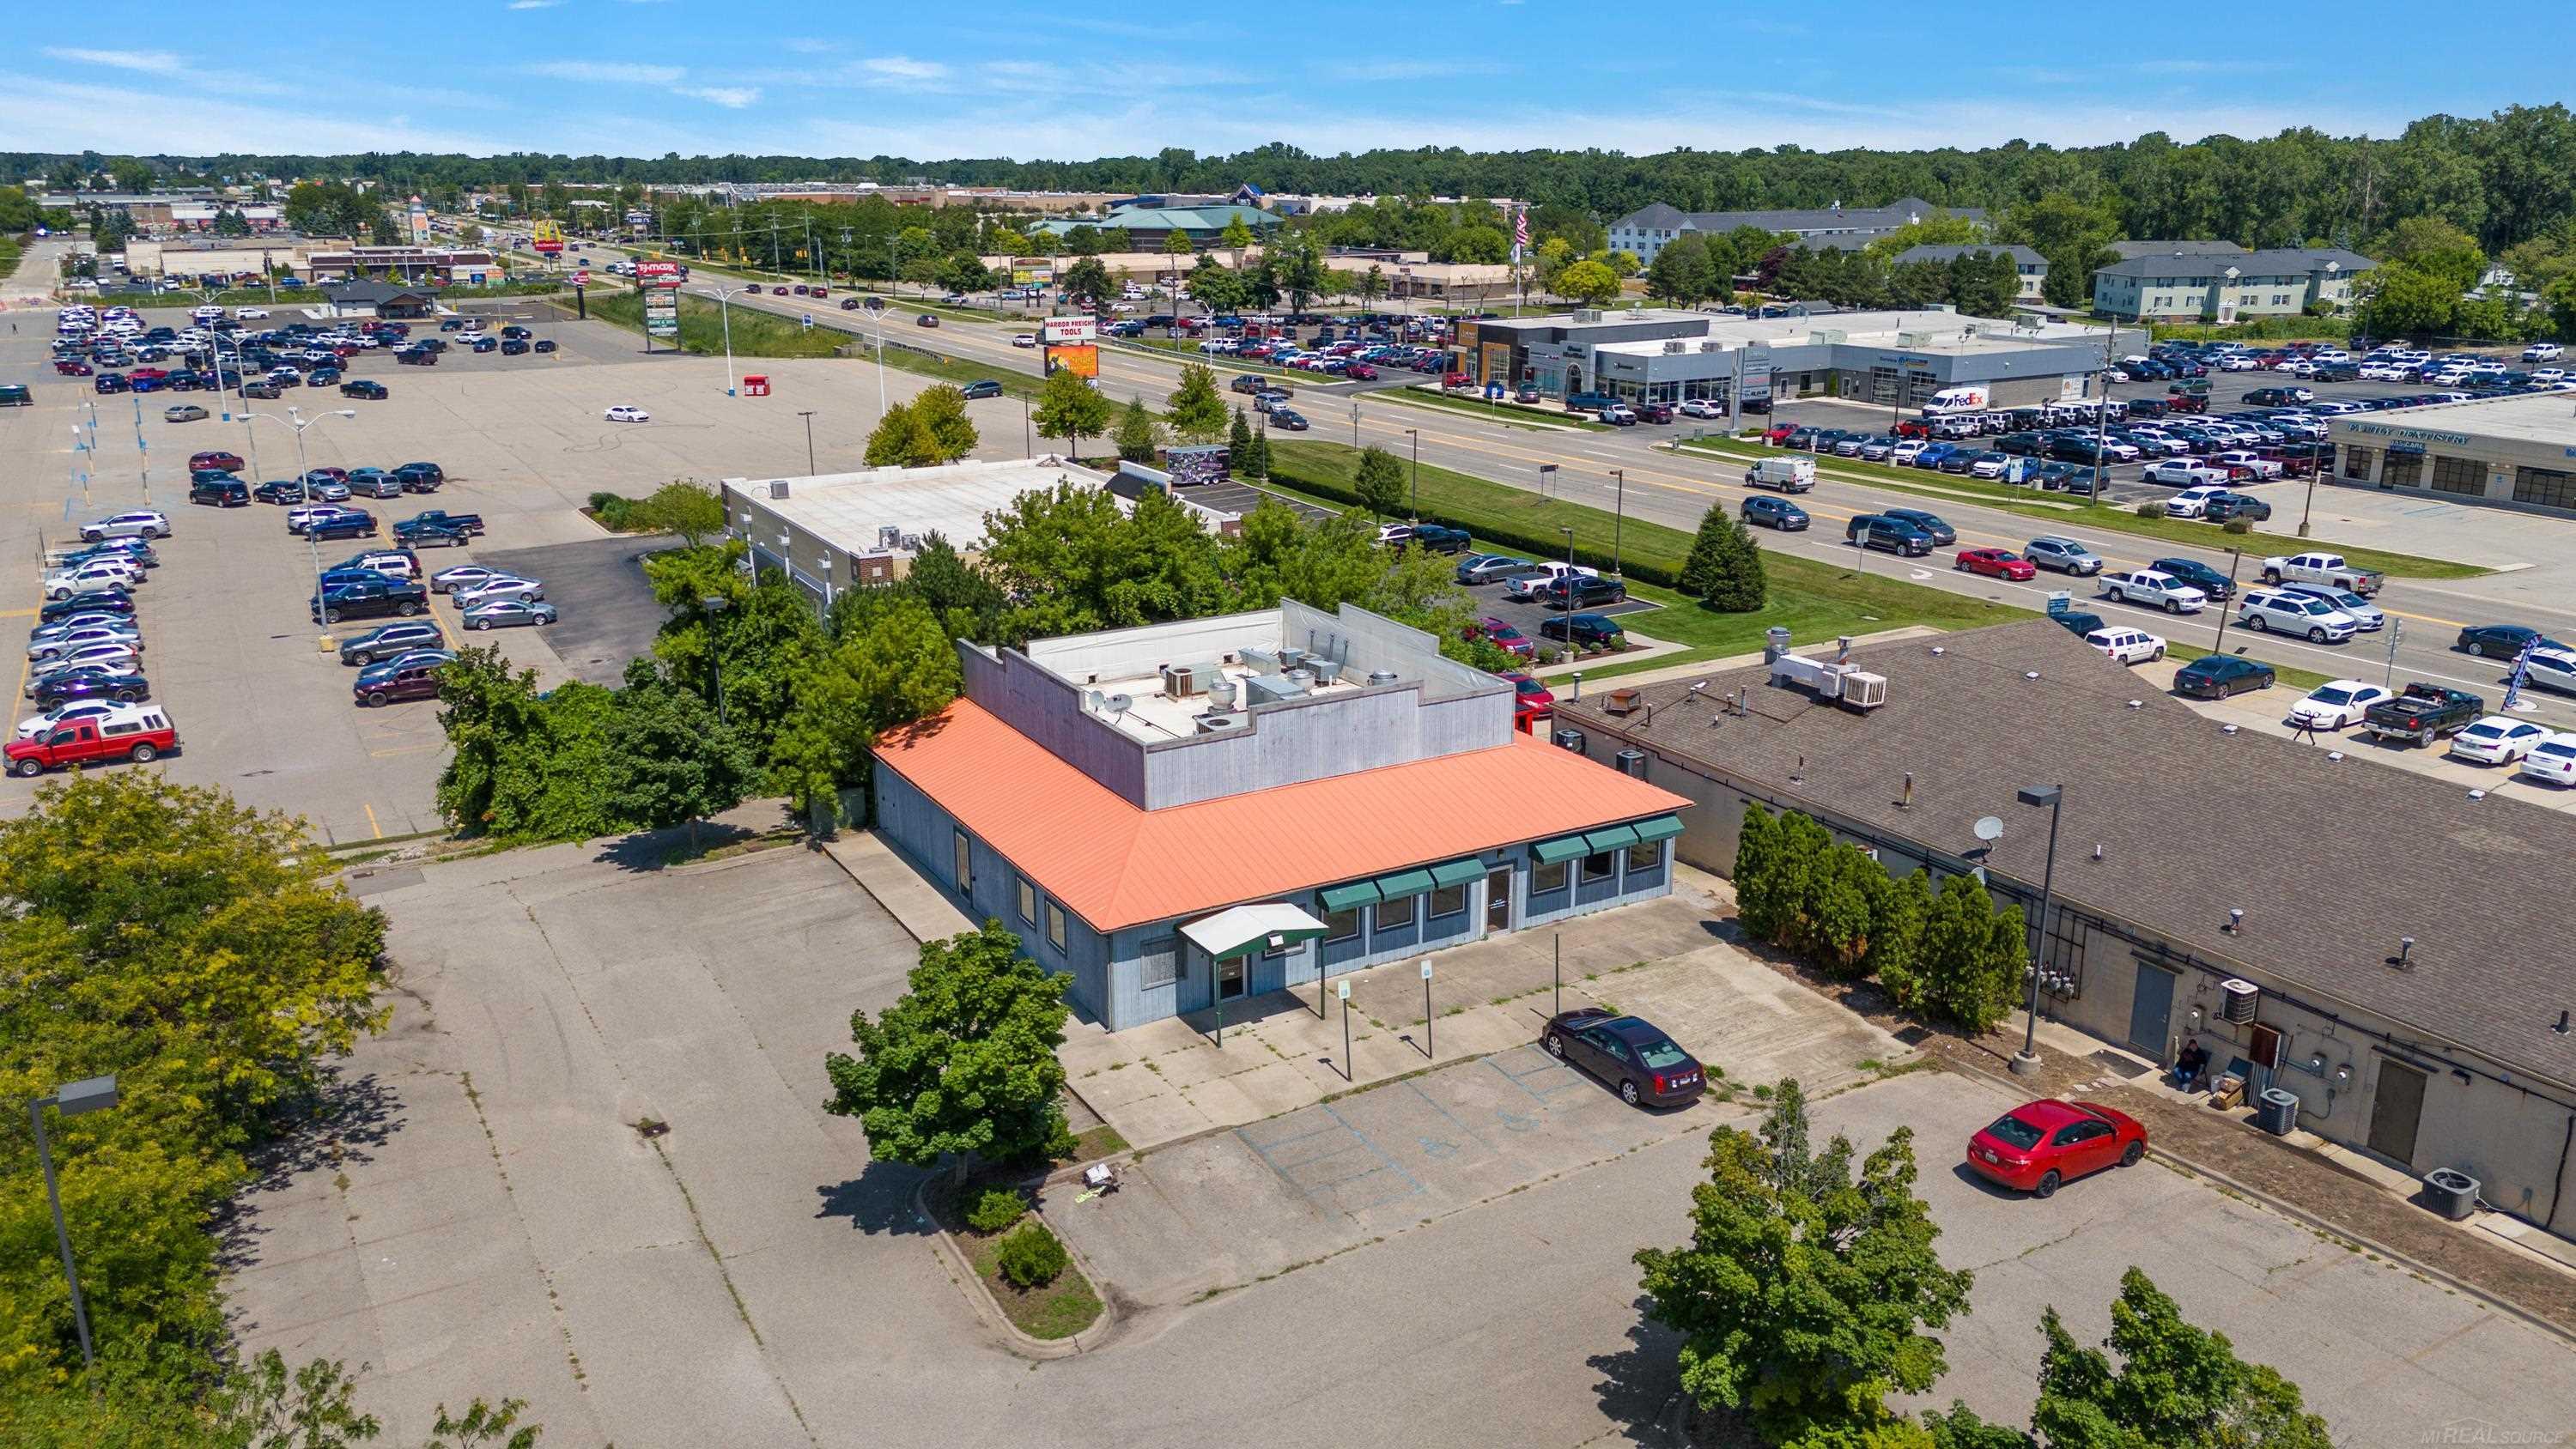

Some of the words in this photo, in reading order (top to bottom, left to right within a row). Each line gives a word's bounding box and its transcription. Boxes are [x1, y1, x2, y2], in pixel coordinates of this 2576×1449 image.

[1954, 392, 1983, 406] FedEx
[2348, 422, 2391, 435] FAMILY
[2397, 429, 2469, 445] DENTISTRY
